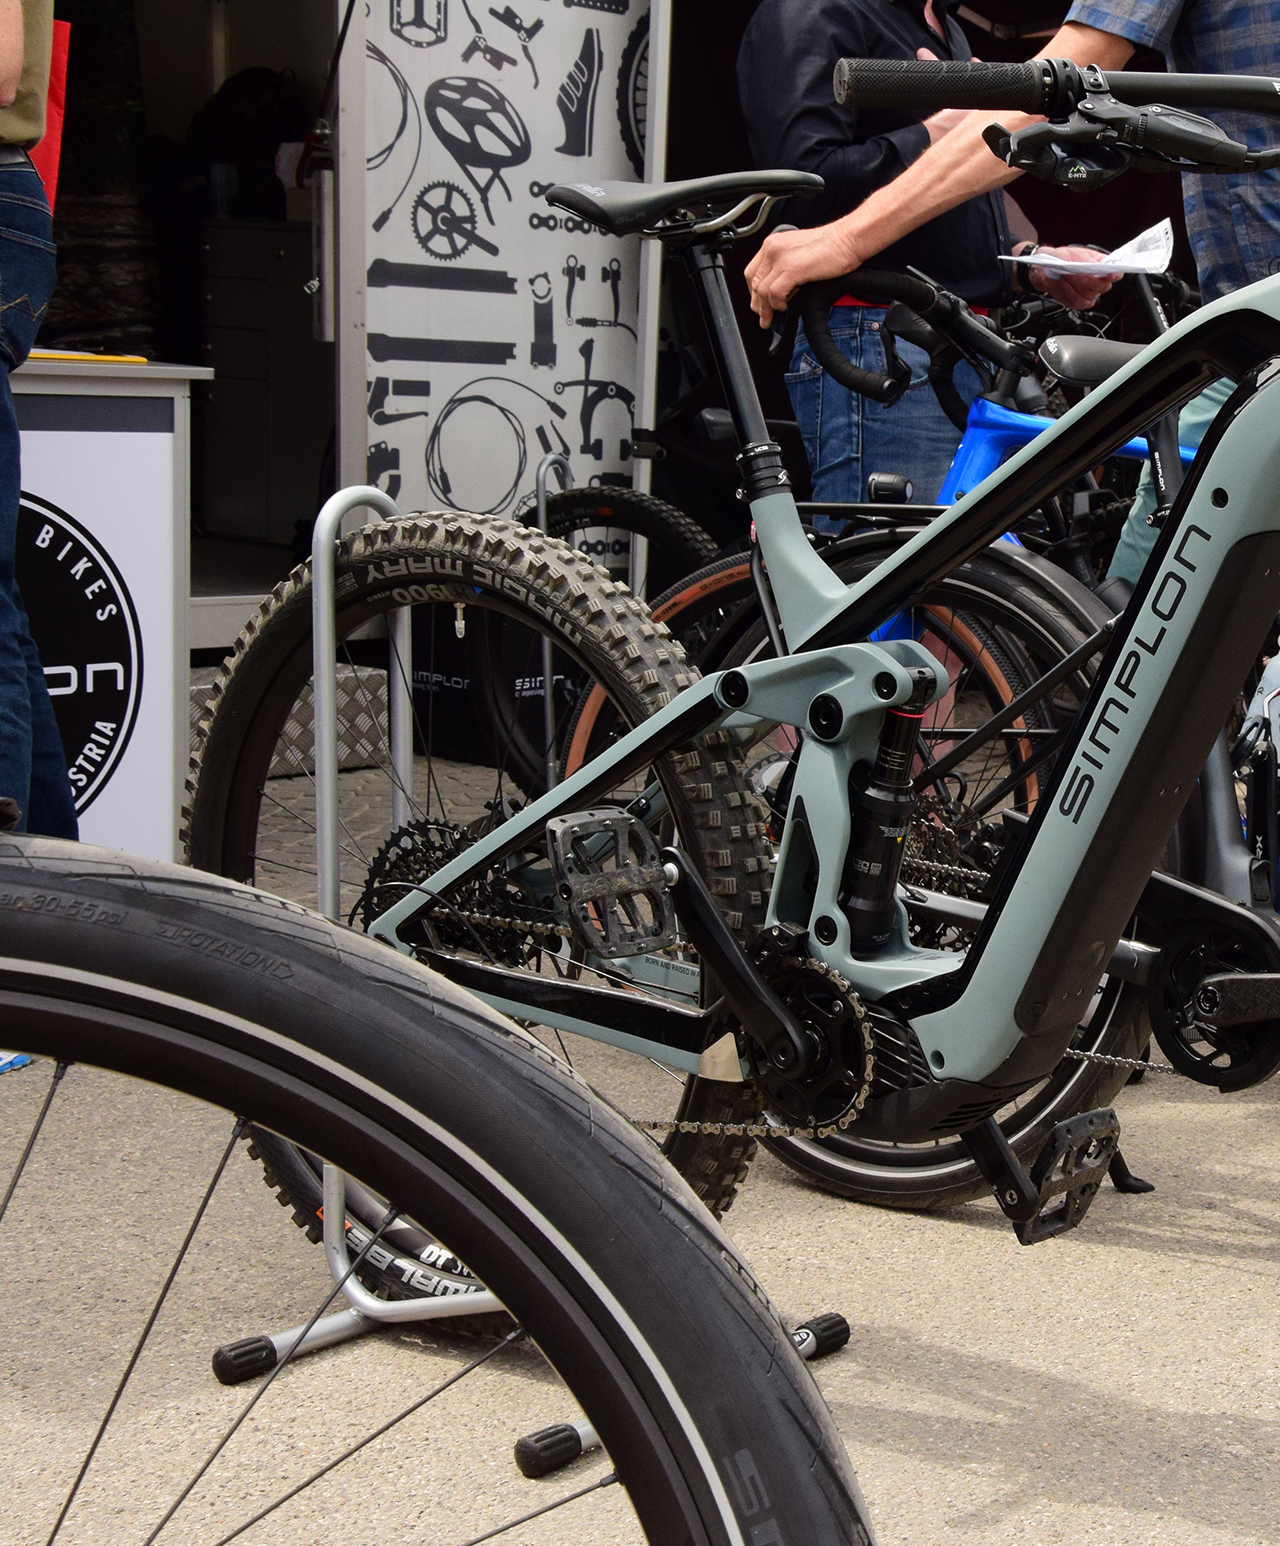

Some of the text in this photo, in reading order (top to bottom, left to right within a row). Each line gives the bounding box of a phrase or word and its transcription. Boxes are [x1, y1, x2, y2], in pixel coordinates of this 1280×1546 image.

[1154, 451, 1166, 491] SIMPLON
[35, 524, 118, 621] BIKES
[366, 556, 464, 584] MARY
[472, 564, 583, 646] MAGIC
[1059, 524, 1212, 824] SIMPLON
[68, 720, 117, 791] STRIA
[171, 925, 277, 977] ROTATION
[645, 957, 659, 966] BORN
[660, 962, 671, 970] AND
[672, 964, 689, 975] RAISED
[346, 1228, 476, 1296] WALBE
[420, 1244, 454, 1269] DT
